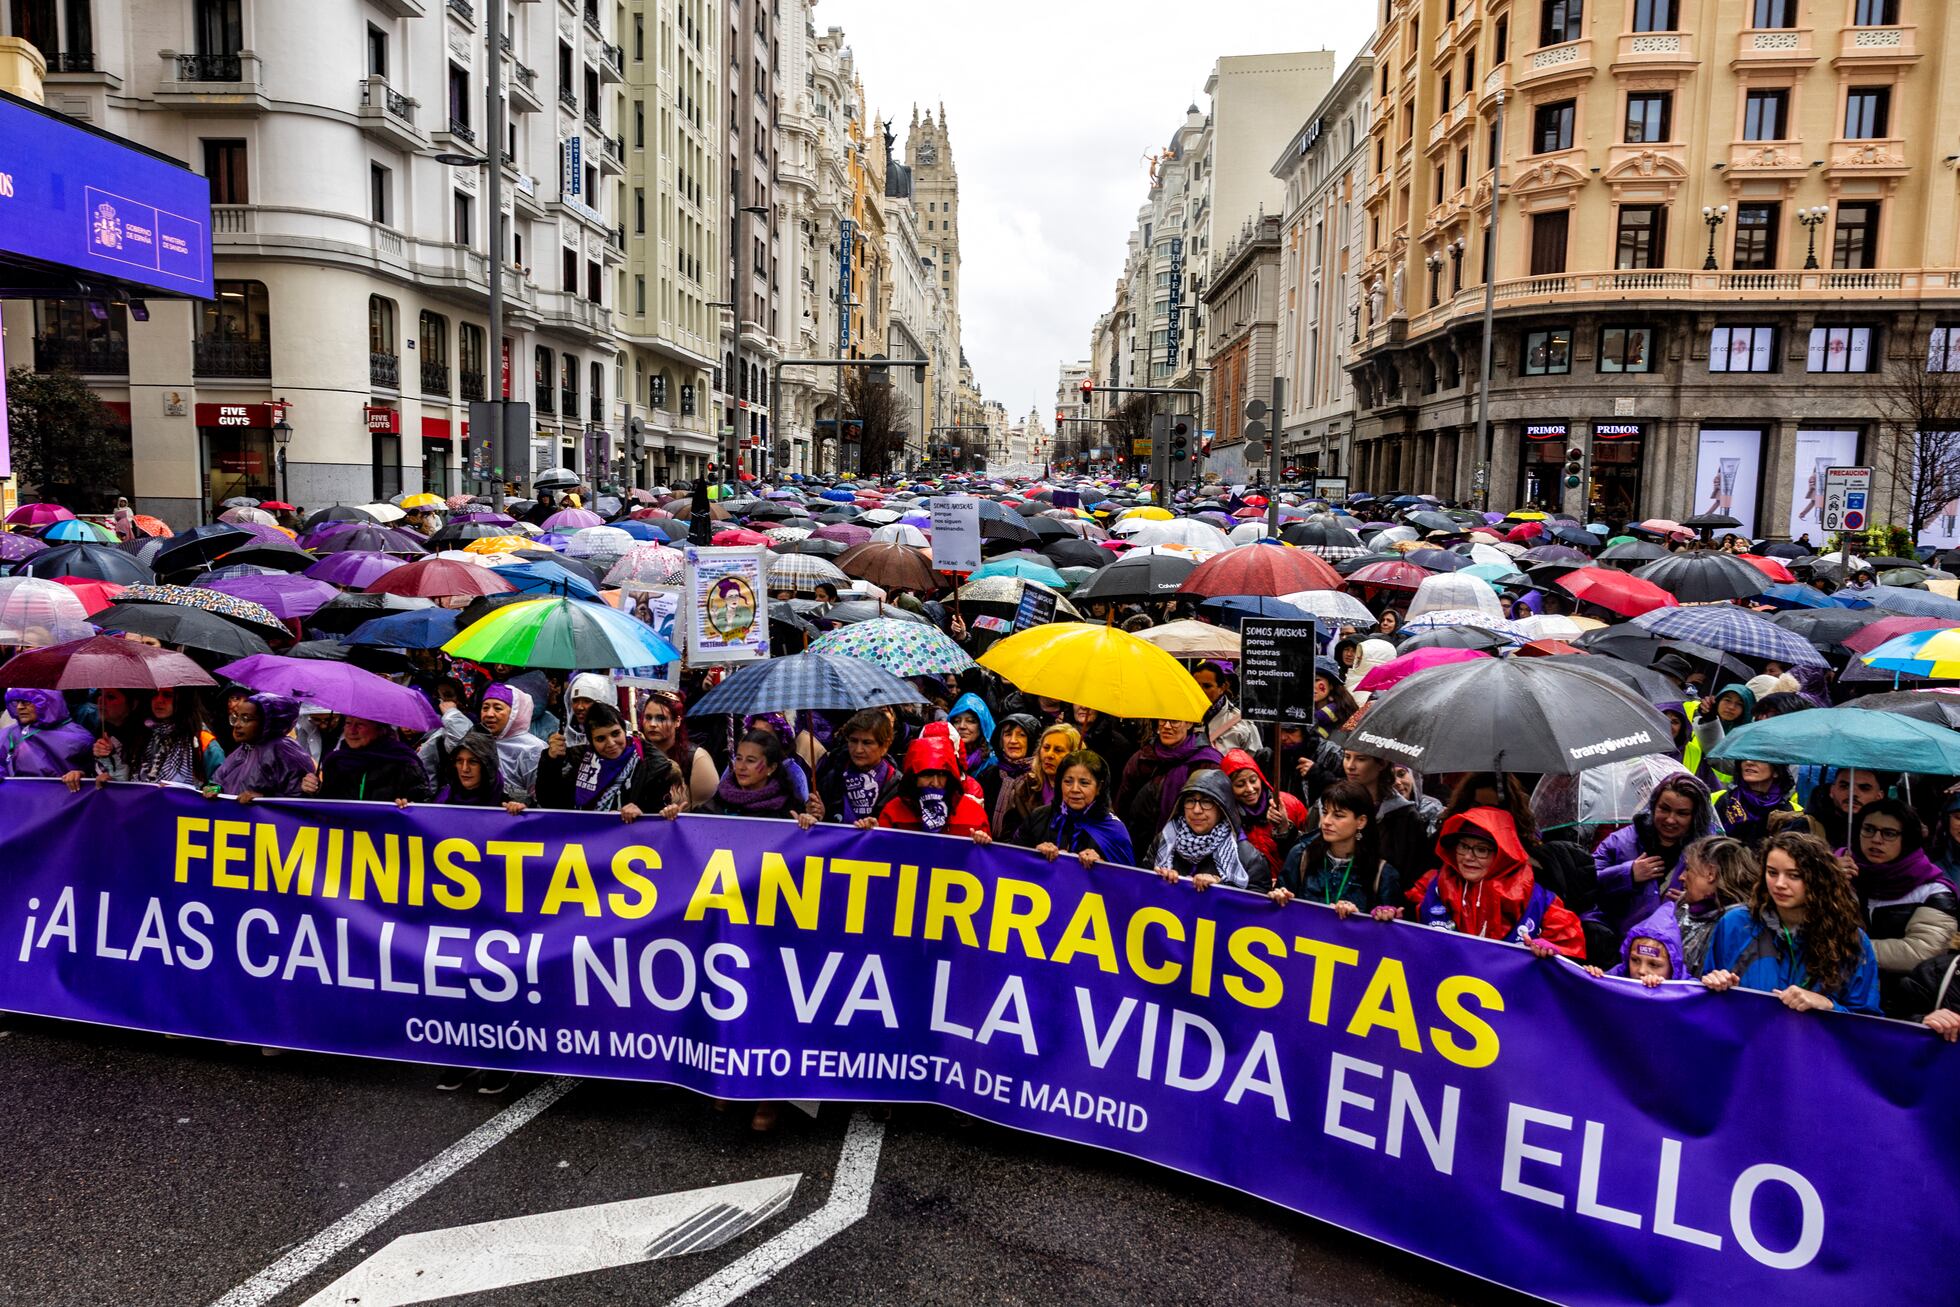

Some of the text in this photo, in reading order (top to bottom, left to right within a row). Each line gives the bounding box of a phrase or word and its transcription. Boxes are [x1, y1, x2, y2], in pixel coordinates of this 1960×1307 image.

[841, 222, 850, 347] HOTEL ATLANTICO
[1168, 254, 1180, 365] HOTEL REGENTE
[220, 406, 247, 416] FIVE
[218, 417, 250, 426] GUYS
[371, 414, 388, 422] FIVE
[369, 421, 391, 429] GUYS
[1527, 425, 1566, 434] PRIMOR
[1597, 425, 1639, 434] PRIMOR
[1246, 627, 1308, 637] SOMOS ARISKAS
[1246, 639, 1275, 647] porque
[1246, 658, 1277, 666] abuelas
[1258, 669, 1295, 678] pudieron
[1358, 731, 1424, 758] trangoworld
[1570, 730, 1652, 759] trangoworld
[174, 816, 1505, 1068] FEMINISTAS ANTIRRACISTAS
[18, 886, 1825, 1270] ¡A LAS CALLES! NOS VA LA VIDA EN ELLO
[406, 1017, 1148, 1133] COMISIÓN 8M MOVIMIENTO FEMINISTA DE MADRID
